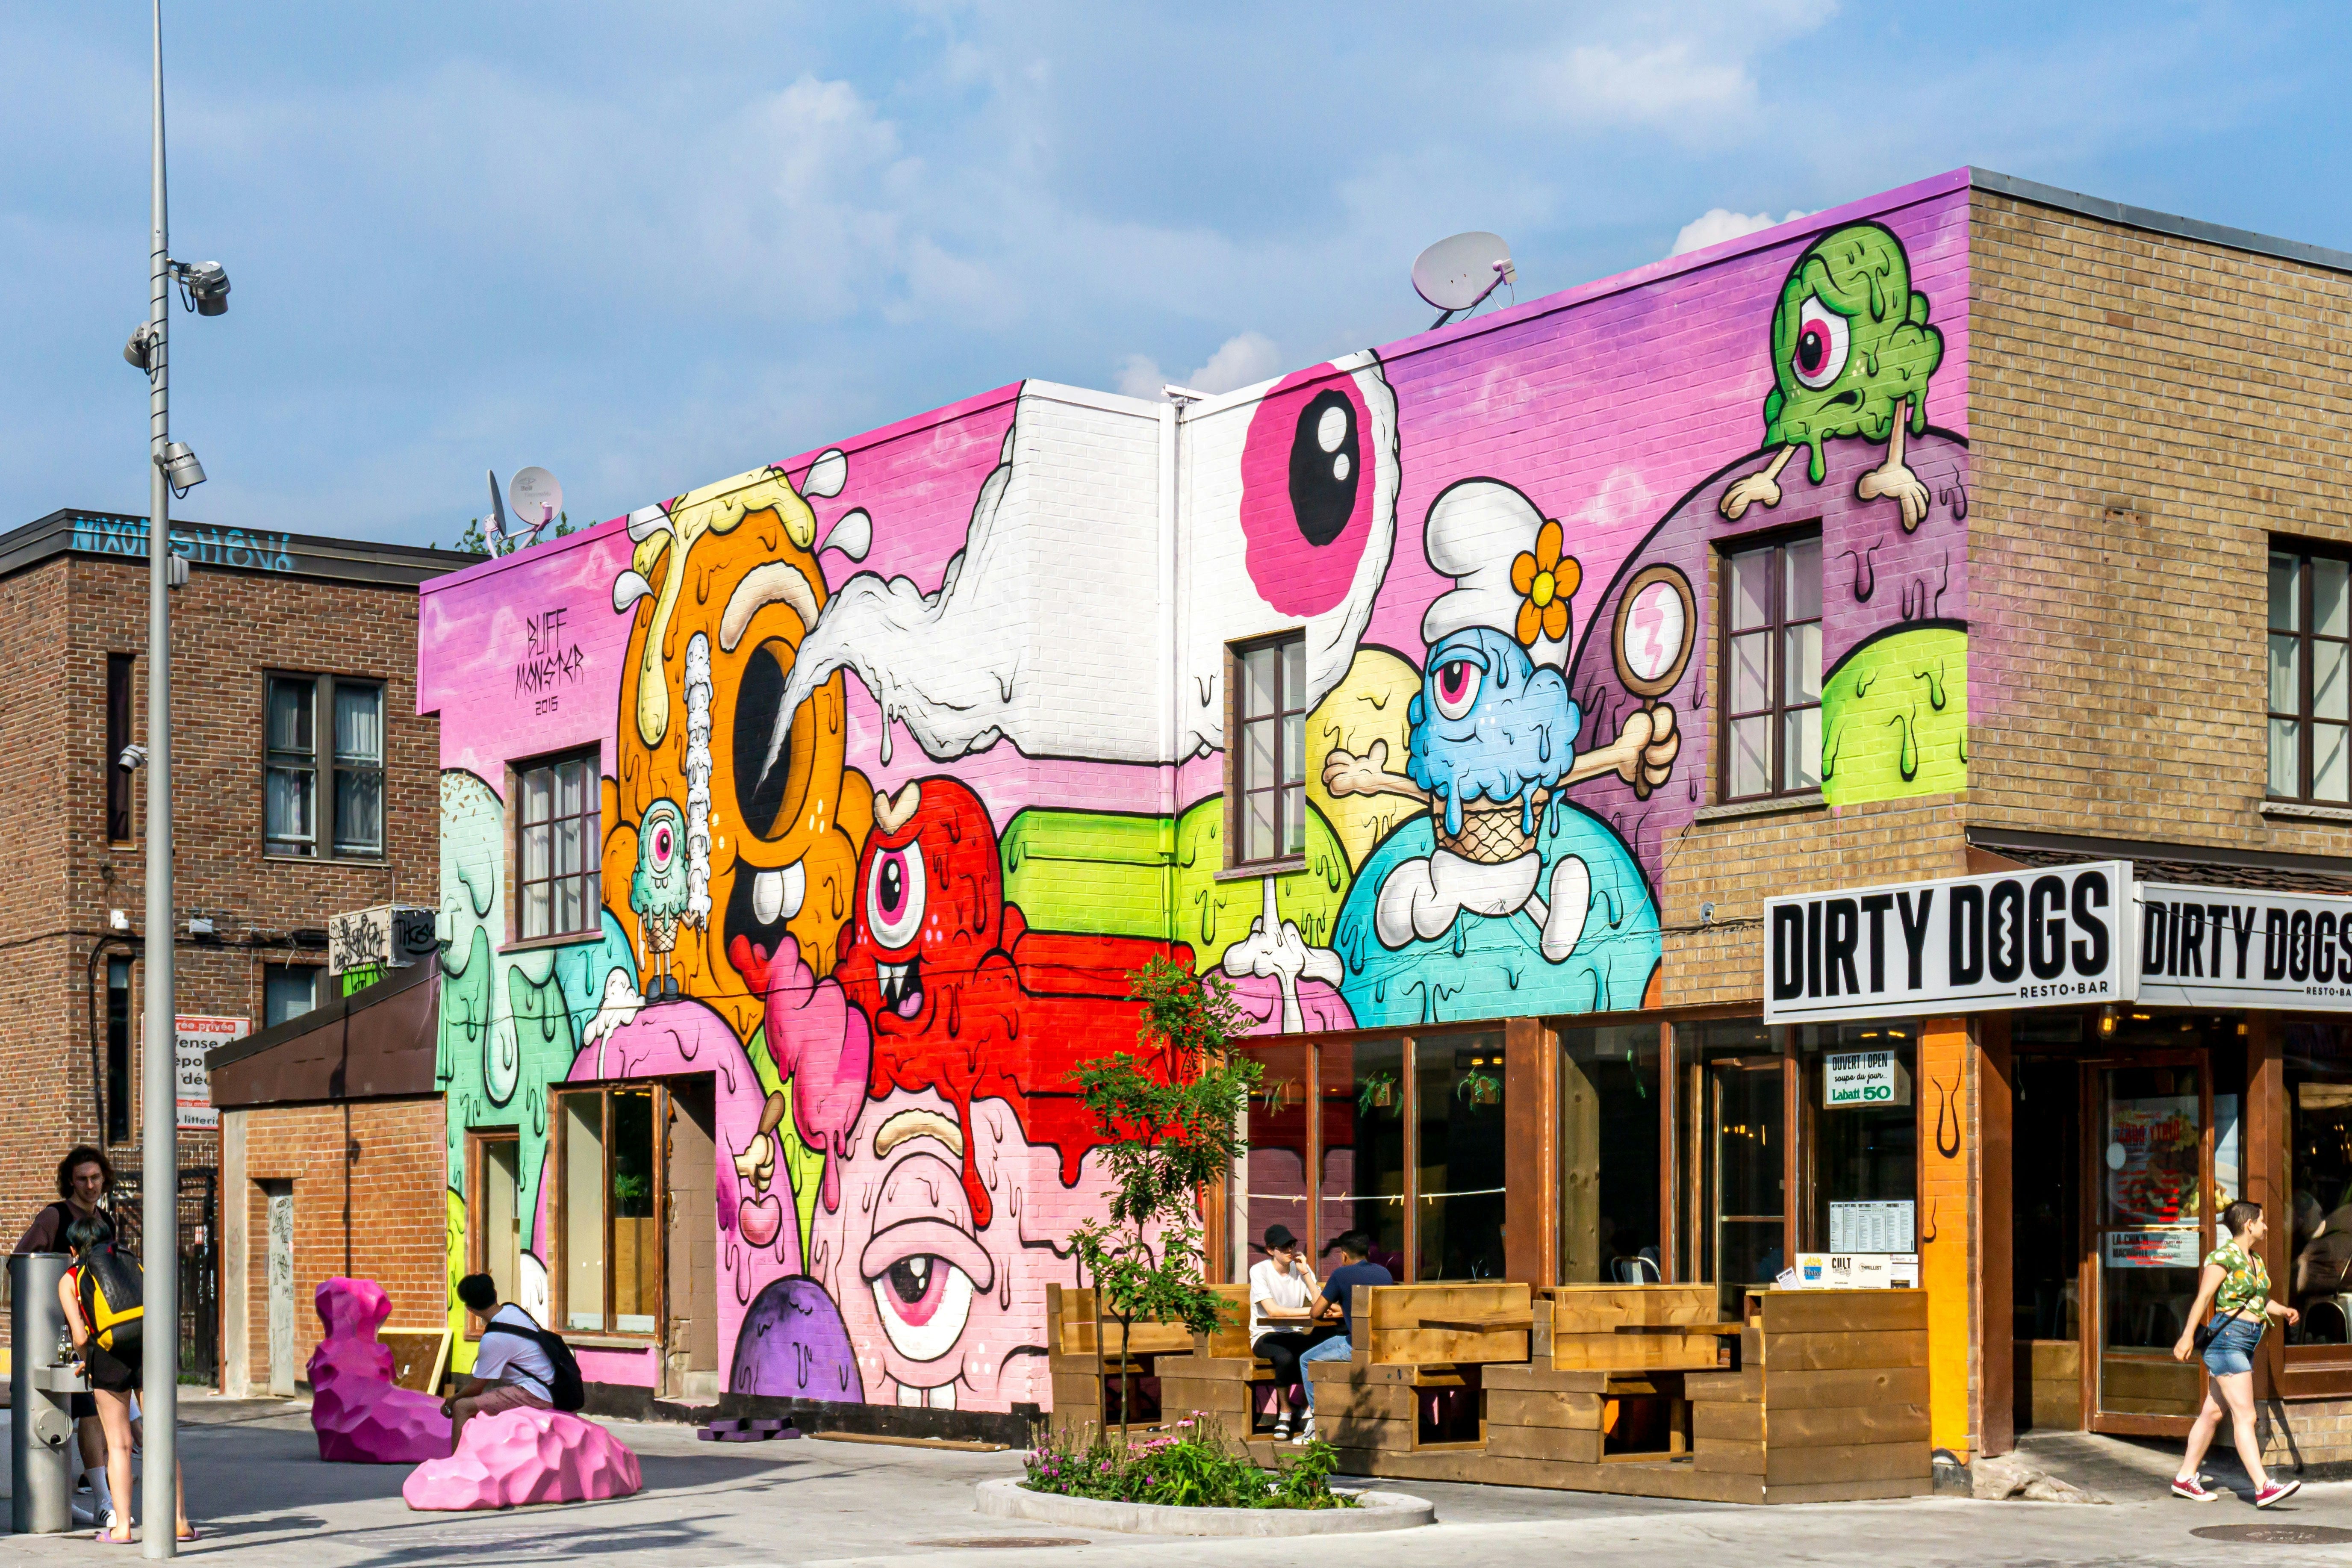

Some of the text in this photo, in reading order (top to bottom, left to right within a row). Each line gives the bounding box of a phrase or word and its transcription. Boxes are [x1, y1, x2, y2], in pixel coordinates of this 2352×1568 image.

[527, 607, 567, 659] BUFF
[515, 643, 584, 700] MONSTER
[535, 696, 558, 716] 2016
[1773, 871, 2109, 1001] DIRTY DOGS
[2142, 900, 2257, 979] DIRTY
[198, 1020, 235, 1033] privée
[1832, 1053, 1888, 1071] OUVERT OPEN
[1835, 1075, 1855, 1084] soupe
[1832, 1086, 1891, 1101] Labatt 50
[184, 1114, 218, 1125] litteri
[1832, 1258, 1851, 1269] CULT
